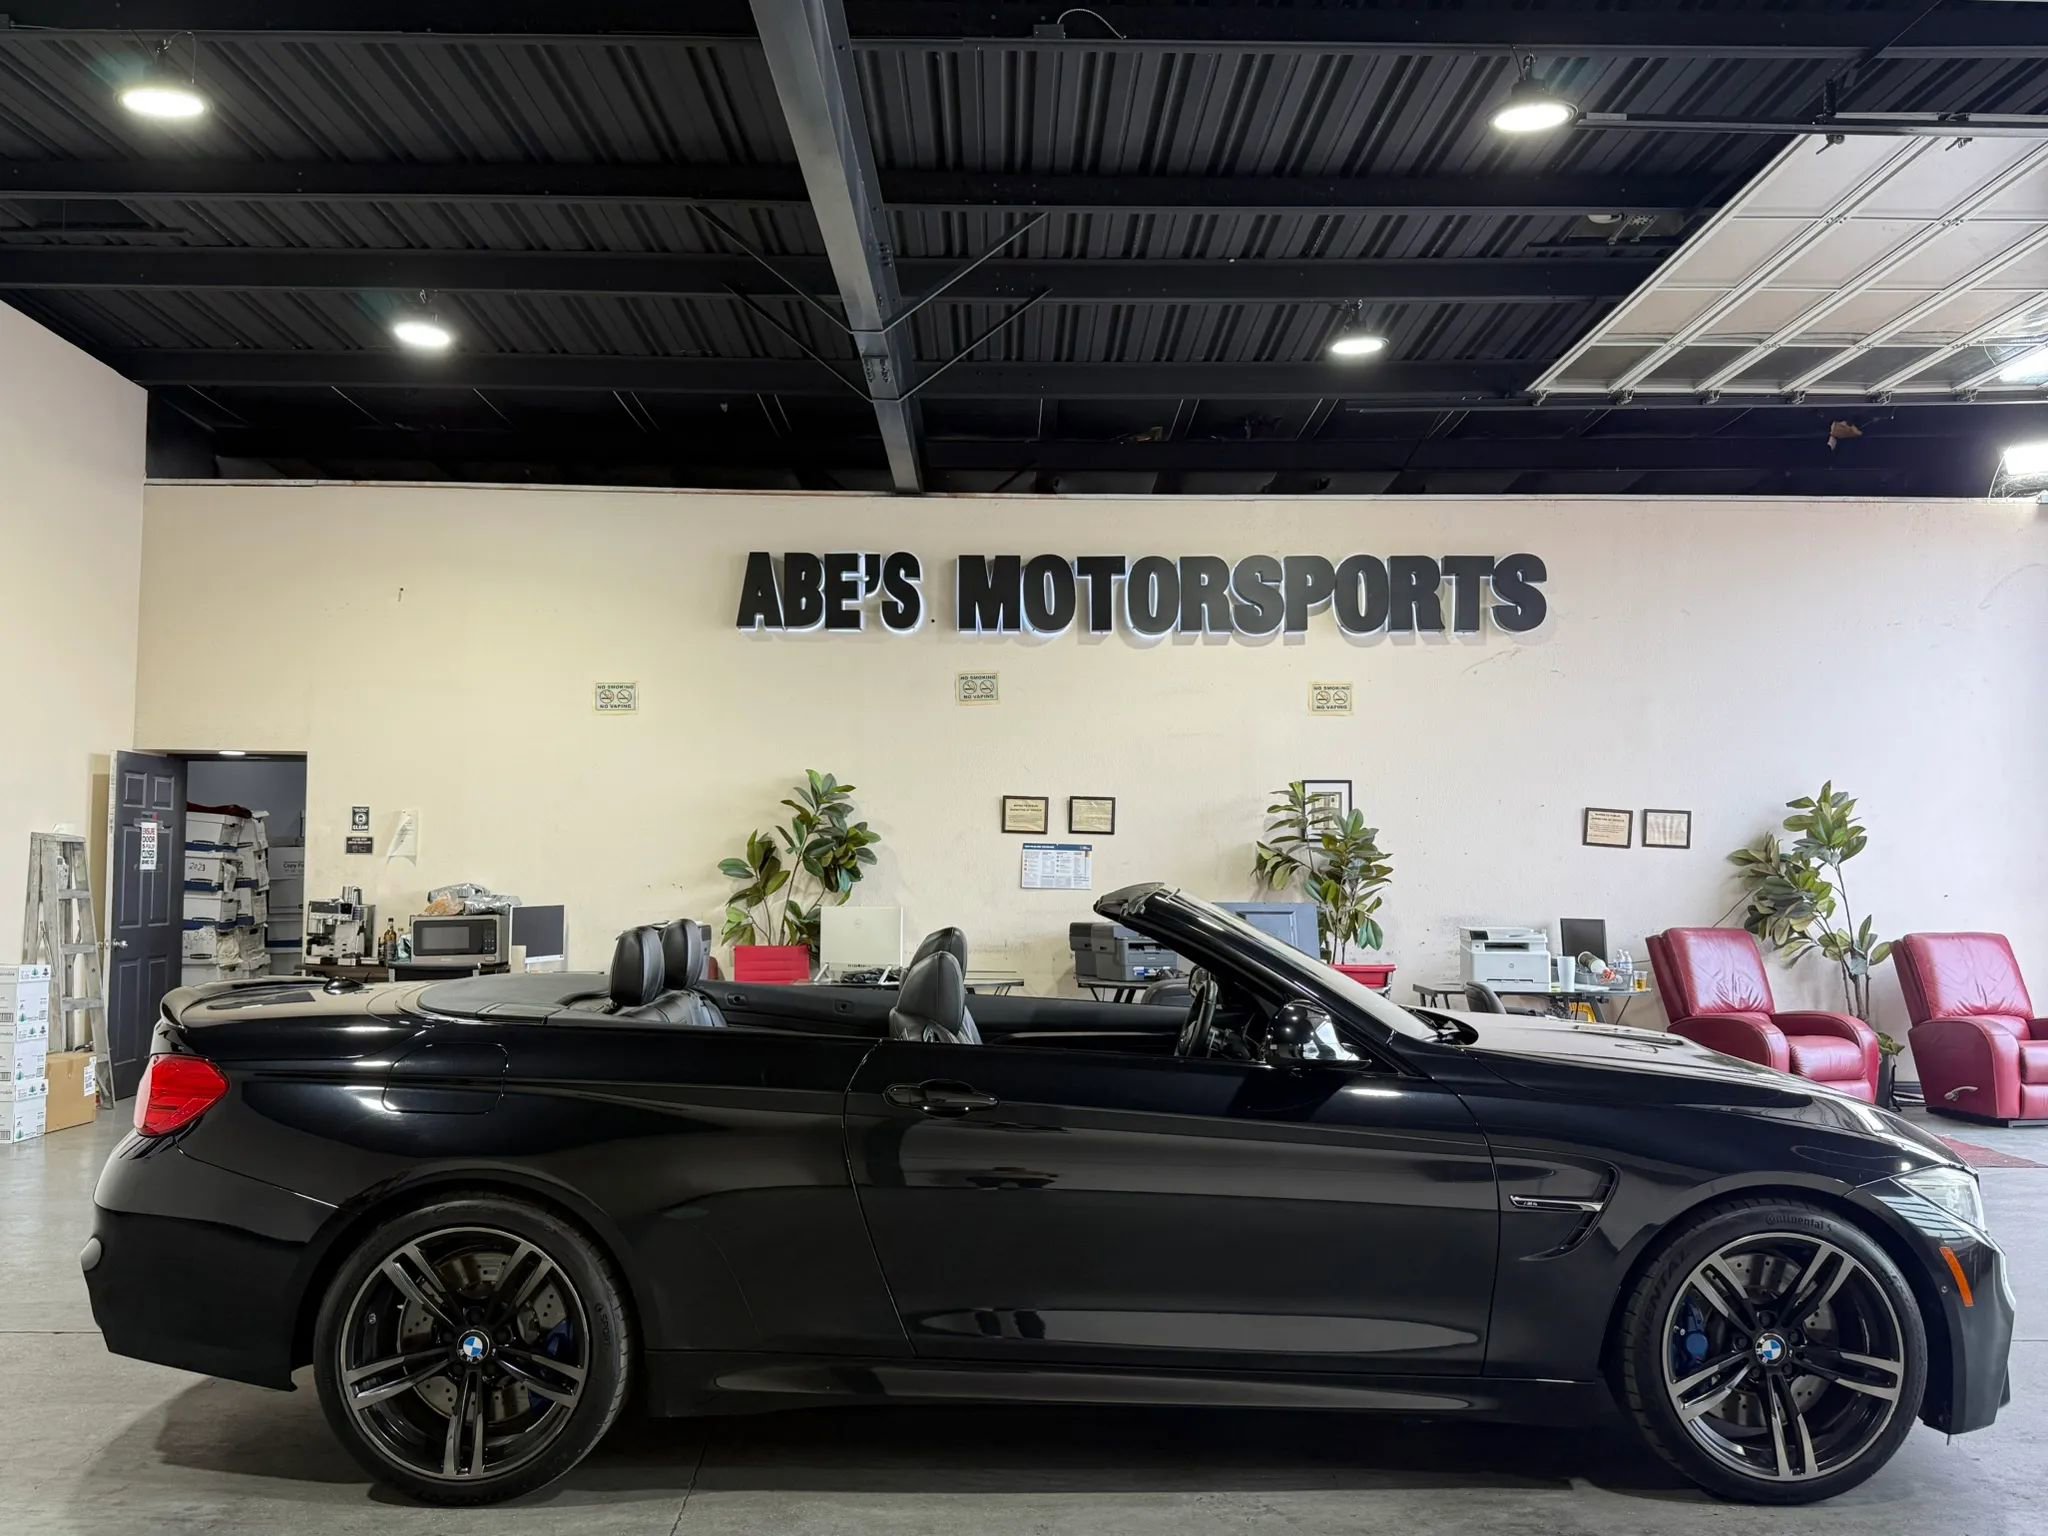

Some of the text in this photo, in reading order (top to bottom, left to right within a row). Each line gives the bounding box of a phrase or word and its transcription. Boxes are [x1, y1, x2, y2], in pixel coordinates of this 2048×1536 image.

[736, 551, 1548, 634] ABE'S MOTORSPORTS
[1764, 1214, 1825, 1230] Continental
